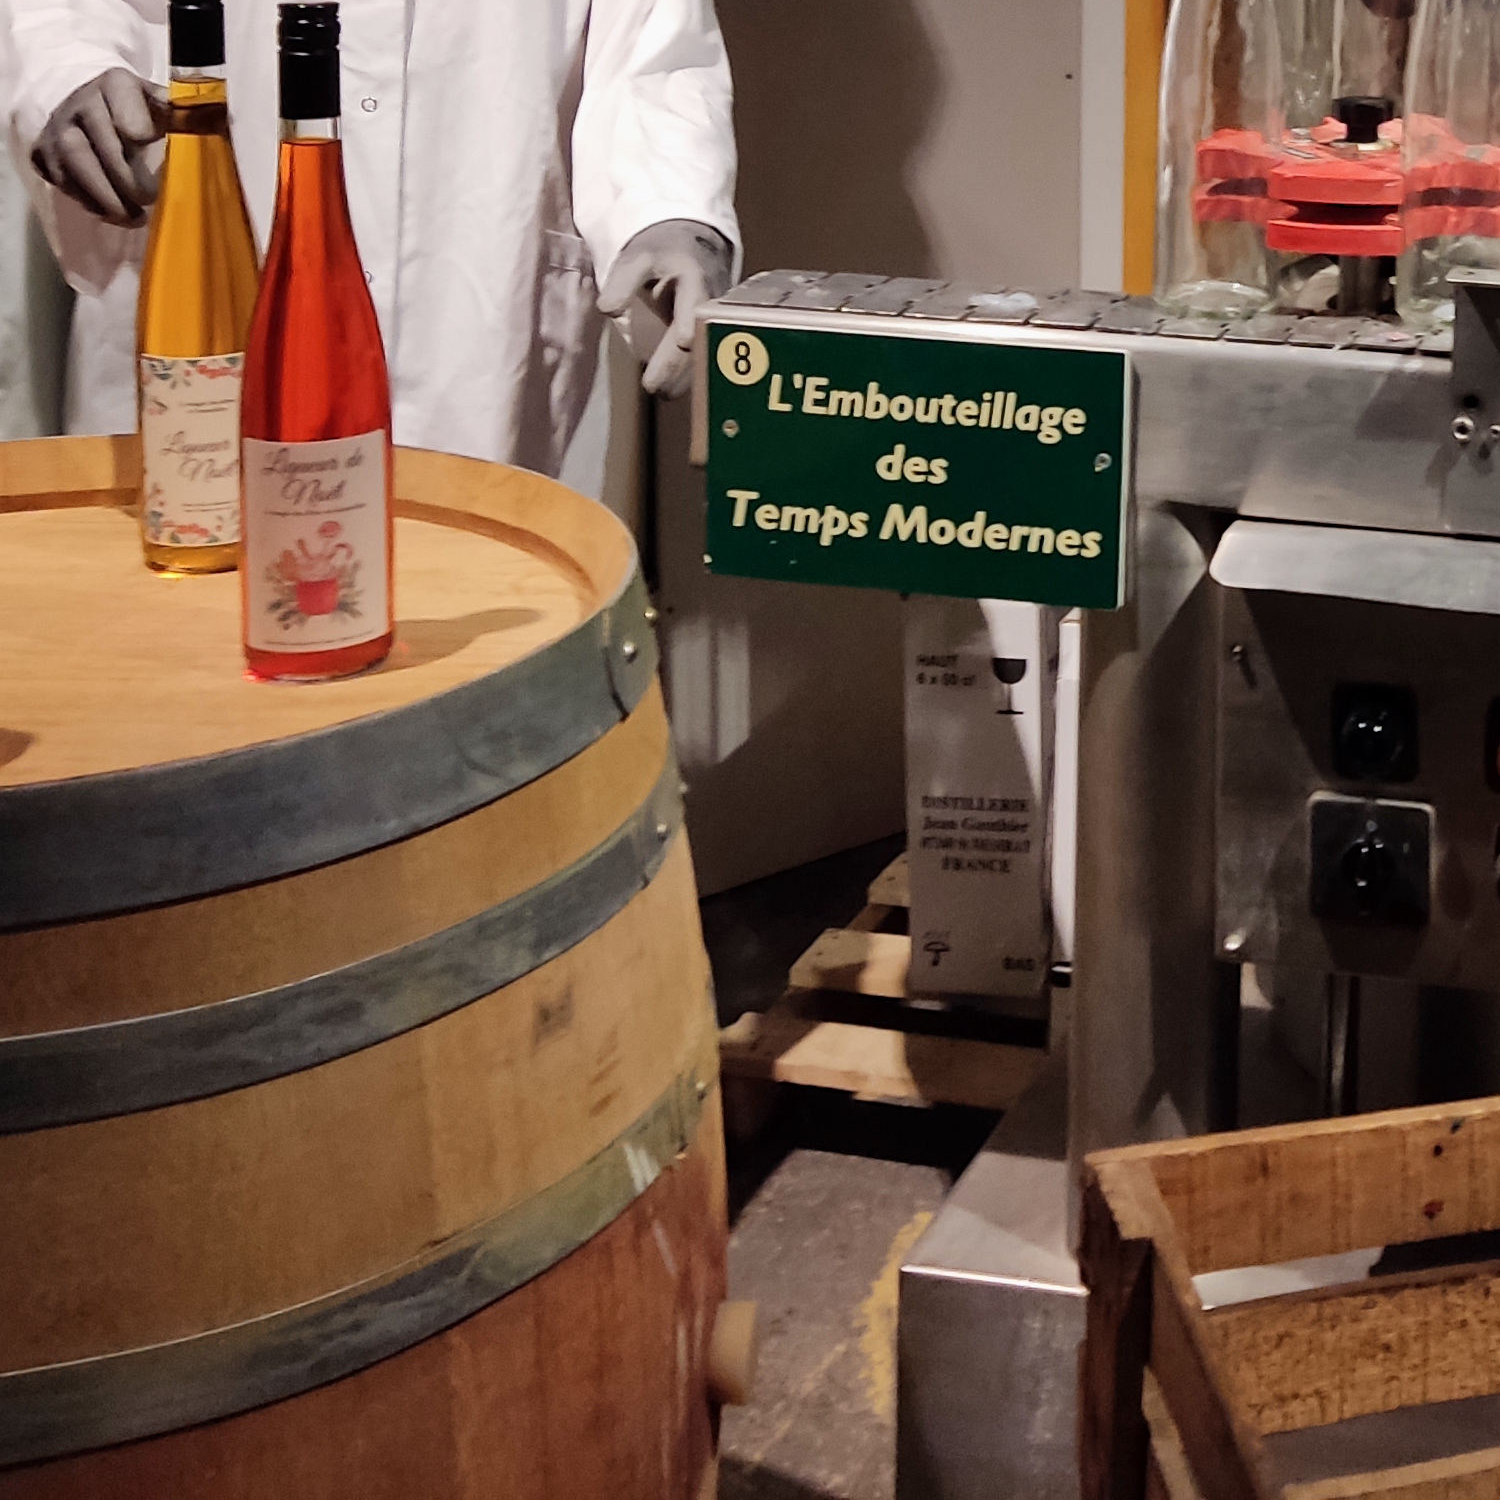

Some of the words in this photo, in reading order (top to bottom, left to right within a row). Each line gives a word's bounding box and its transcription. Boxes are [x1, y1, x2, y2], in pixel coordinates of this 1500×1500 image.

[734, 341, 752, 376] 8
[767, 373, 1088, 445] L'Embouteillage
[875, 443, 950, 485] des
[726, 489, 870, 547] Temps
[878, 503, 1104, 560] Modernes
